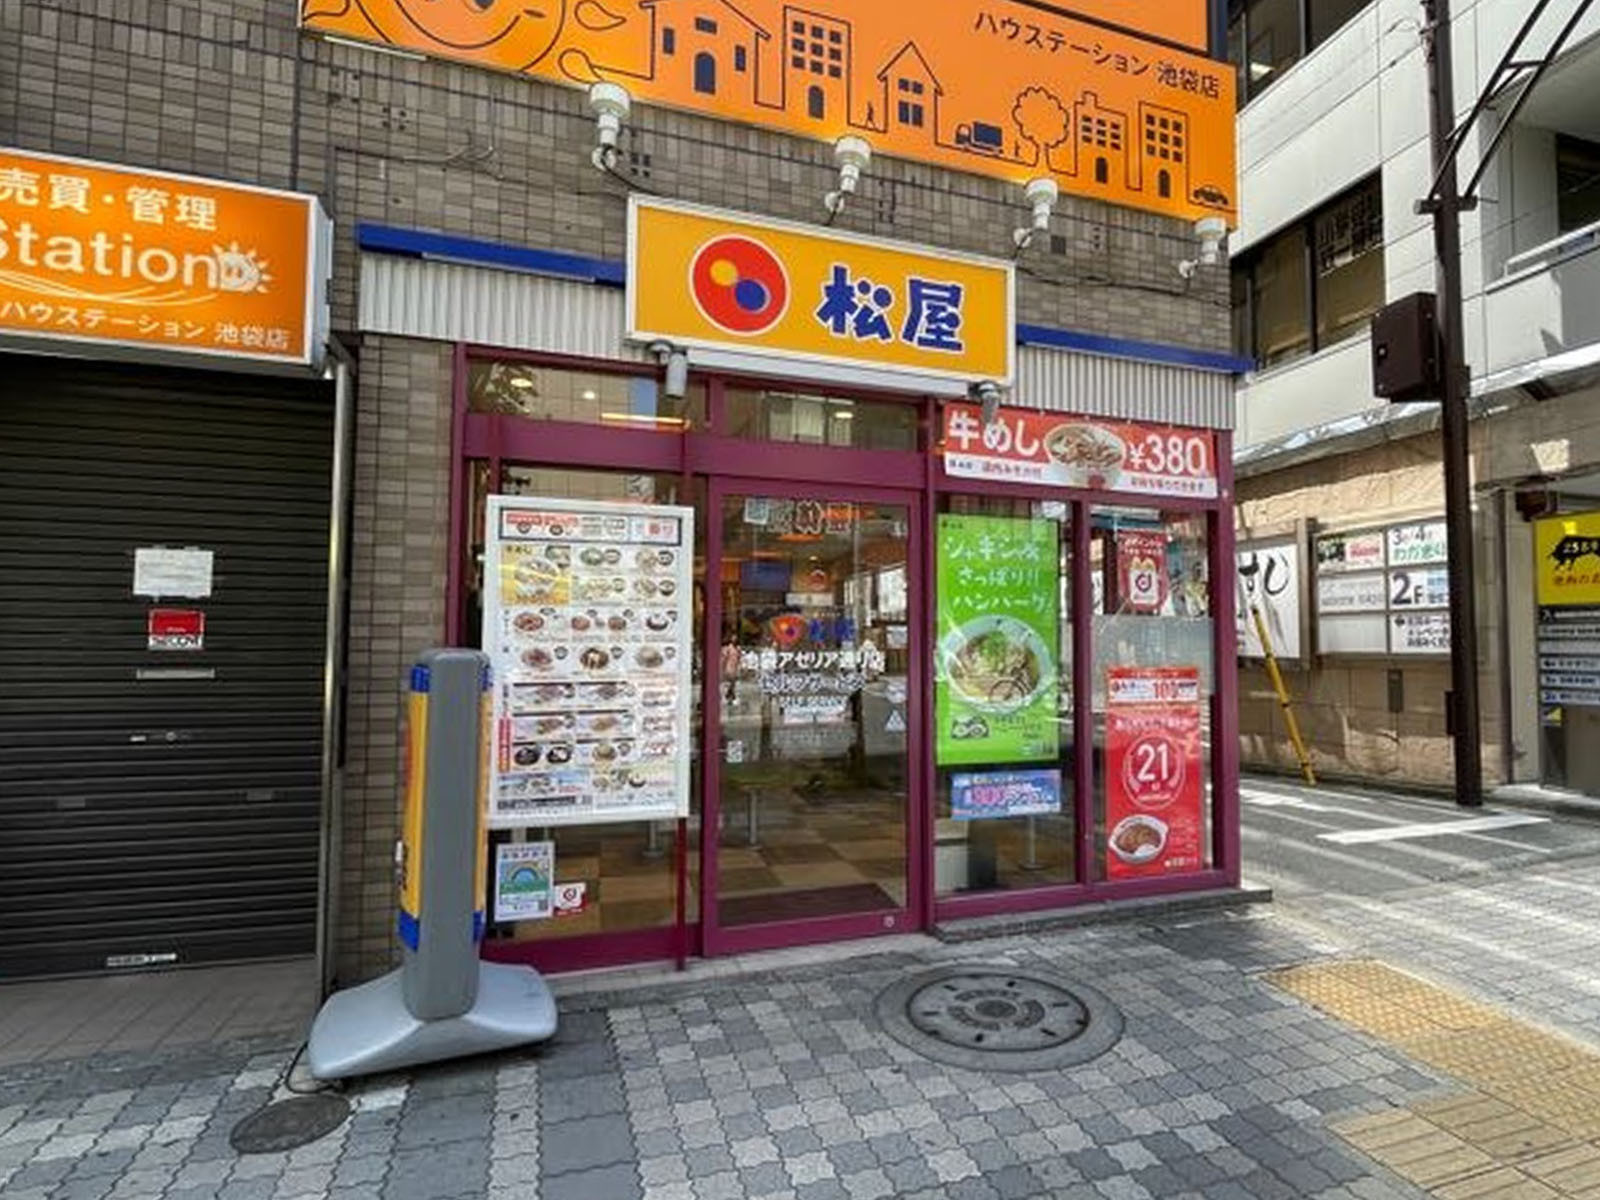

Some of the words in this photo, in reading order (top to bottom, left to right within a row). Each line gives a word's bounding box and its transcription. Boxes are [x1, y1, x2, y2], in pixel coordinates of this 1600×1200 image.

[975, 12, 1150, 76] ハウステーション
[1156, 60, 1220, 99] 池袋店
[0, 167, 218, 232] 売買・管理
[0, 217, 219, 289] tation
[1, 300, 206, 340] ハウステーション
[214, 322, 290, 350] 池袋店
[814, 263, 967, 353] 松屋
[948, 409, 1041, 457] 牛めし
[1128, 433, 1208, 475] ¥380
[1392, 573, 1422, 604] 2F
[1136, 742, 1170, 782] 21
